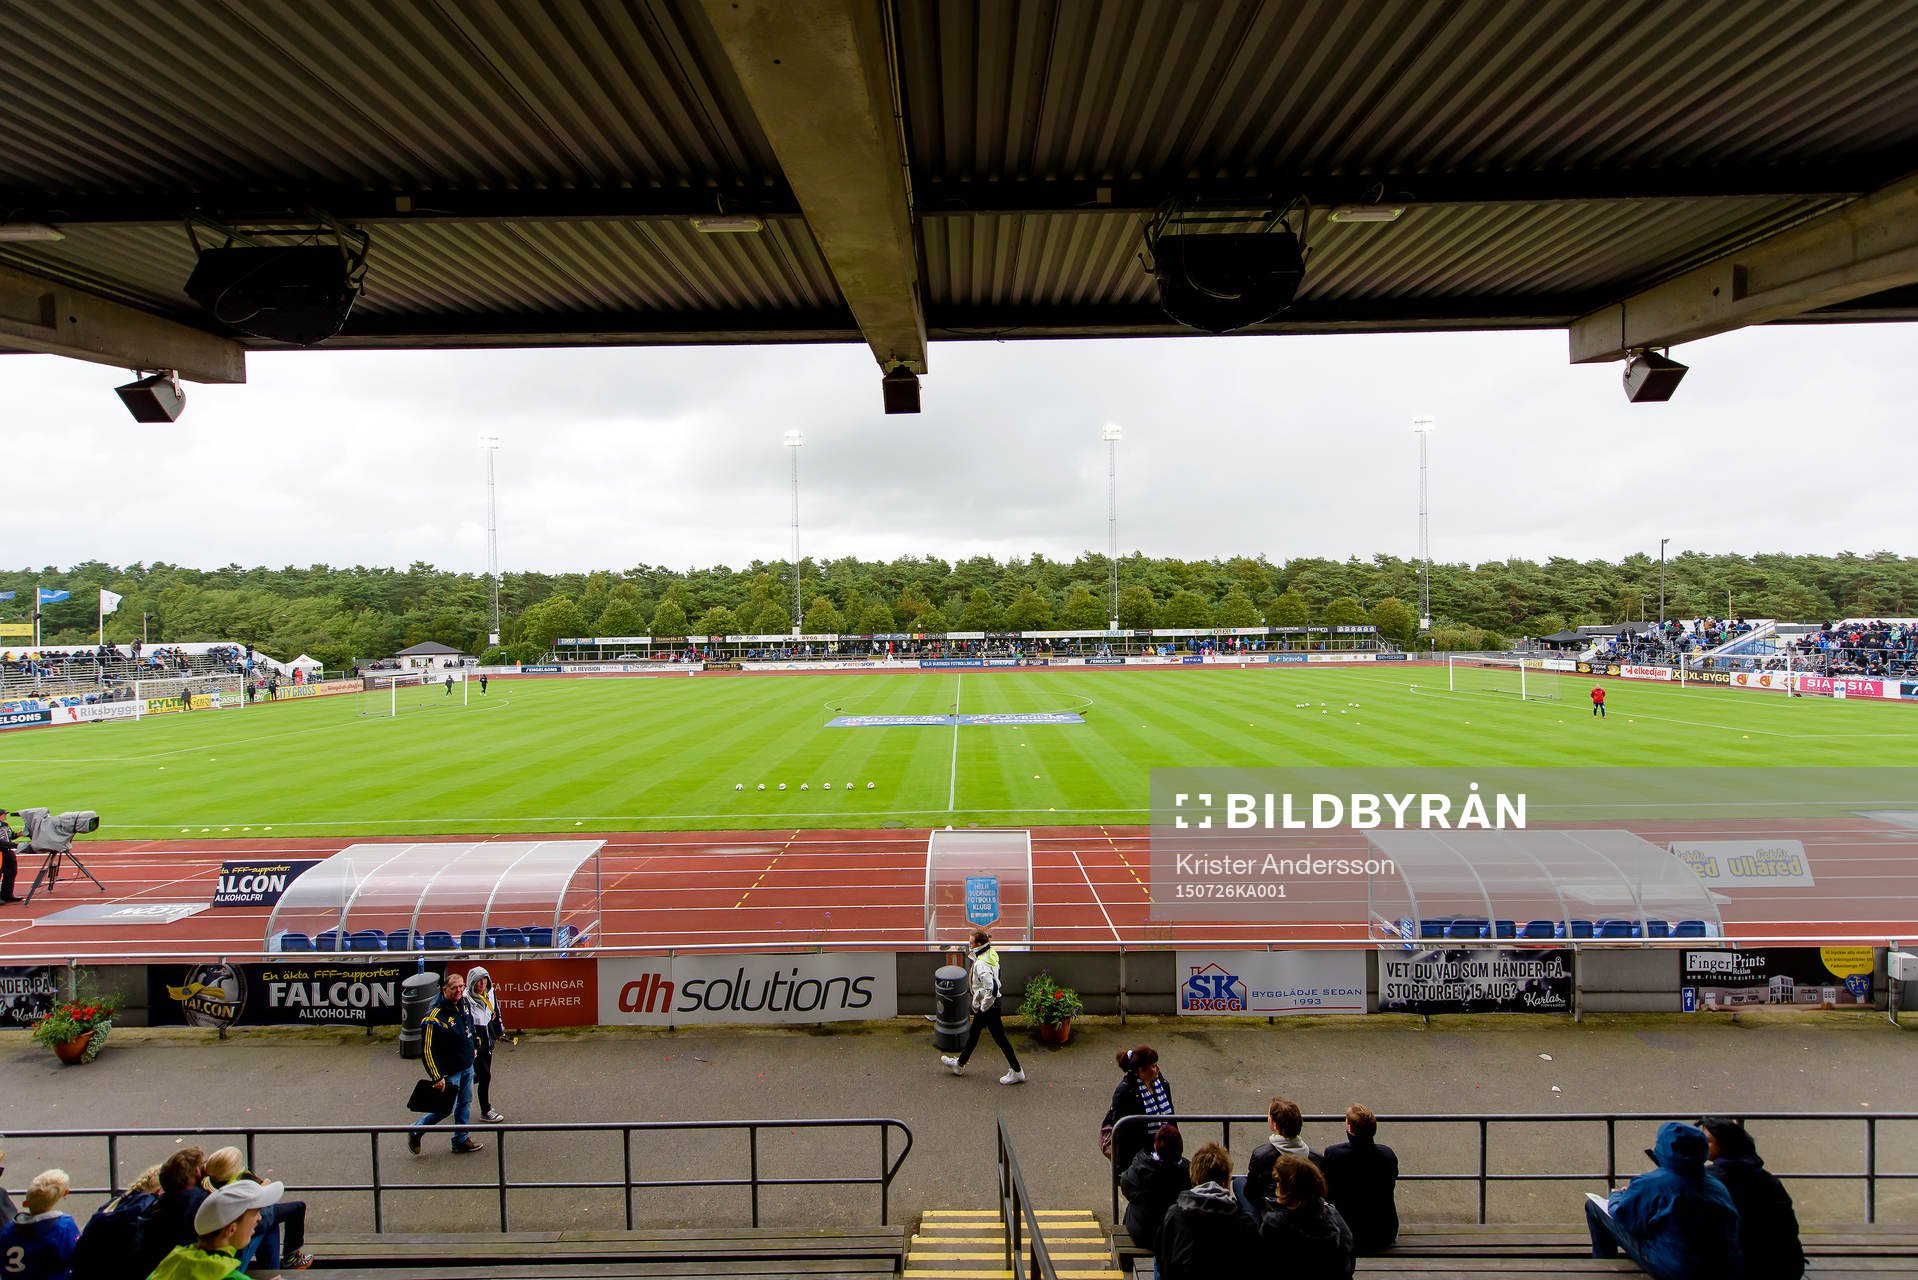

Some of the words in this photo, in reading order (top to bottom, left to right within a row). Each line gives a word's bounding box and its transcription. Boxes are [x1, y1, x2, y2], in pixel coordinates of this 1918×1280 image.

[1688, 672, 1729, 682] XL-BYGG
[1807, 679, 1831, 688] SIA
[1847, 681, 1874, 691] SIA
[80, 703, 145, 717] Riksbyggen
[1728, 855, 1803, 877] Ullared
[215, 893, 263, 902] ALKOHOLFRI
[1386, 962, 1410, 978] VET
[1414, 963, 1433, 979] DU
[1436, 962, 1458, 979] VAD
[1462, 961, 1489, 978] SOM
[1493, 957, 1543, 978] HÄNDER
[1547, 956, 1563, 978] PÅ
[1688, 954, 1731, 973] Finger
[1732, 953, 1766, 968] Prints
[34, 972, 50, 993] PÅ
[262, 972, 279, 981] En
[283, 970, 309, 980] äkta
[314, 968, 400, 983] FFF-supporter:
[504, 979, 584, 992] IT-LÖSNINGAR
[618, 973, 675, 1013] dh
[677, 967, 875, 1012] solutions
[1188, 975, 1239, 1000] SK
[1252, 987, 1318, 998] BYGGLÄDJE
[1322, 988, 1362, 996] SEDAN
[1387, 982, 1466, 1000] STORTORGET
[1469, 984, 1483, 998] 15
[1486, 983, 1518, 998] AUG?
[269, 981, 396, 1007] FALCON
[1524, 991, 1560, 1006] Karlas
[497, 999, 524, 1009] TTRE
[528, 996, 581, 1009] AFFÄRER
[1189, 999, 1241, 1012] BYGG
[1293, 998, 1321, 1006] 1993
[299, 1008, 366, 1019] ALKOHOLFRI
[5, 1246, 26, 1273] 3
